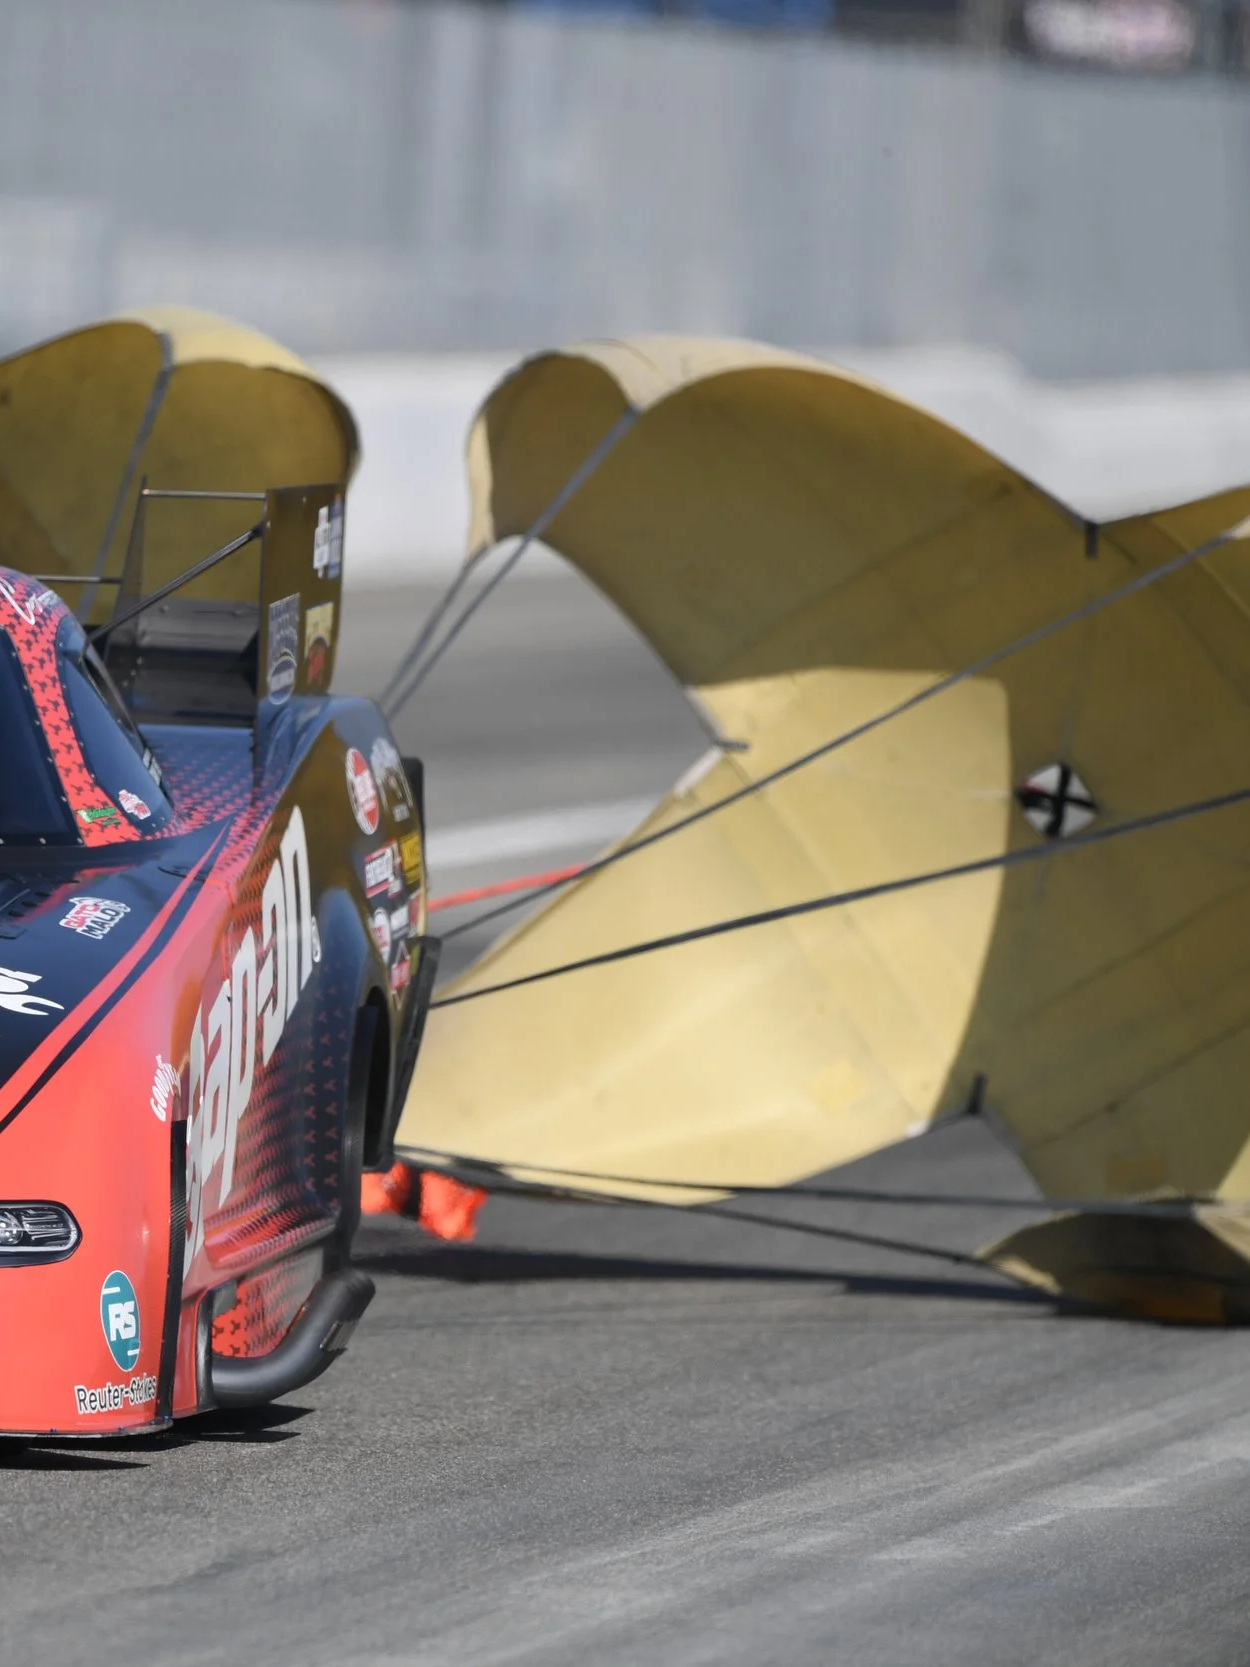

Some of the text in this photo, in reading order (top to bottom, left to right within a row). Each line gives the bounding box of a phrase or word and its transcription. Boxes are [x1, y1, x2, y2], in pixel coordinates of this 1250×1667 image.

[63, 903, 101, 928] GATO
[81, 907, 121, 939] MALO
[108, 1300, 137, 1342] RS
[75, 1375, 158, 1414] Reuter-Stokes
